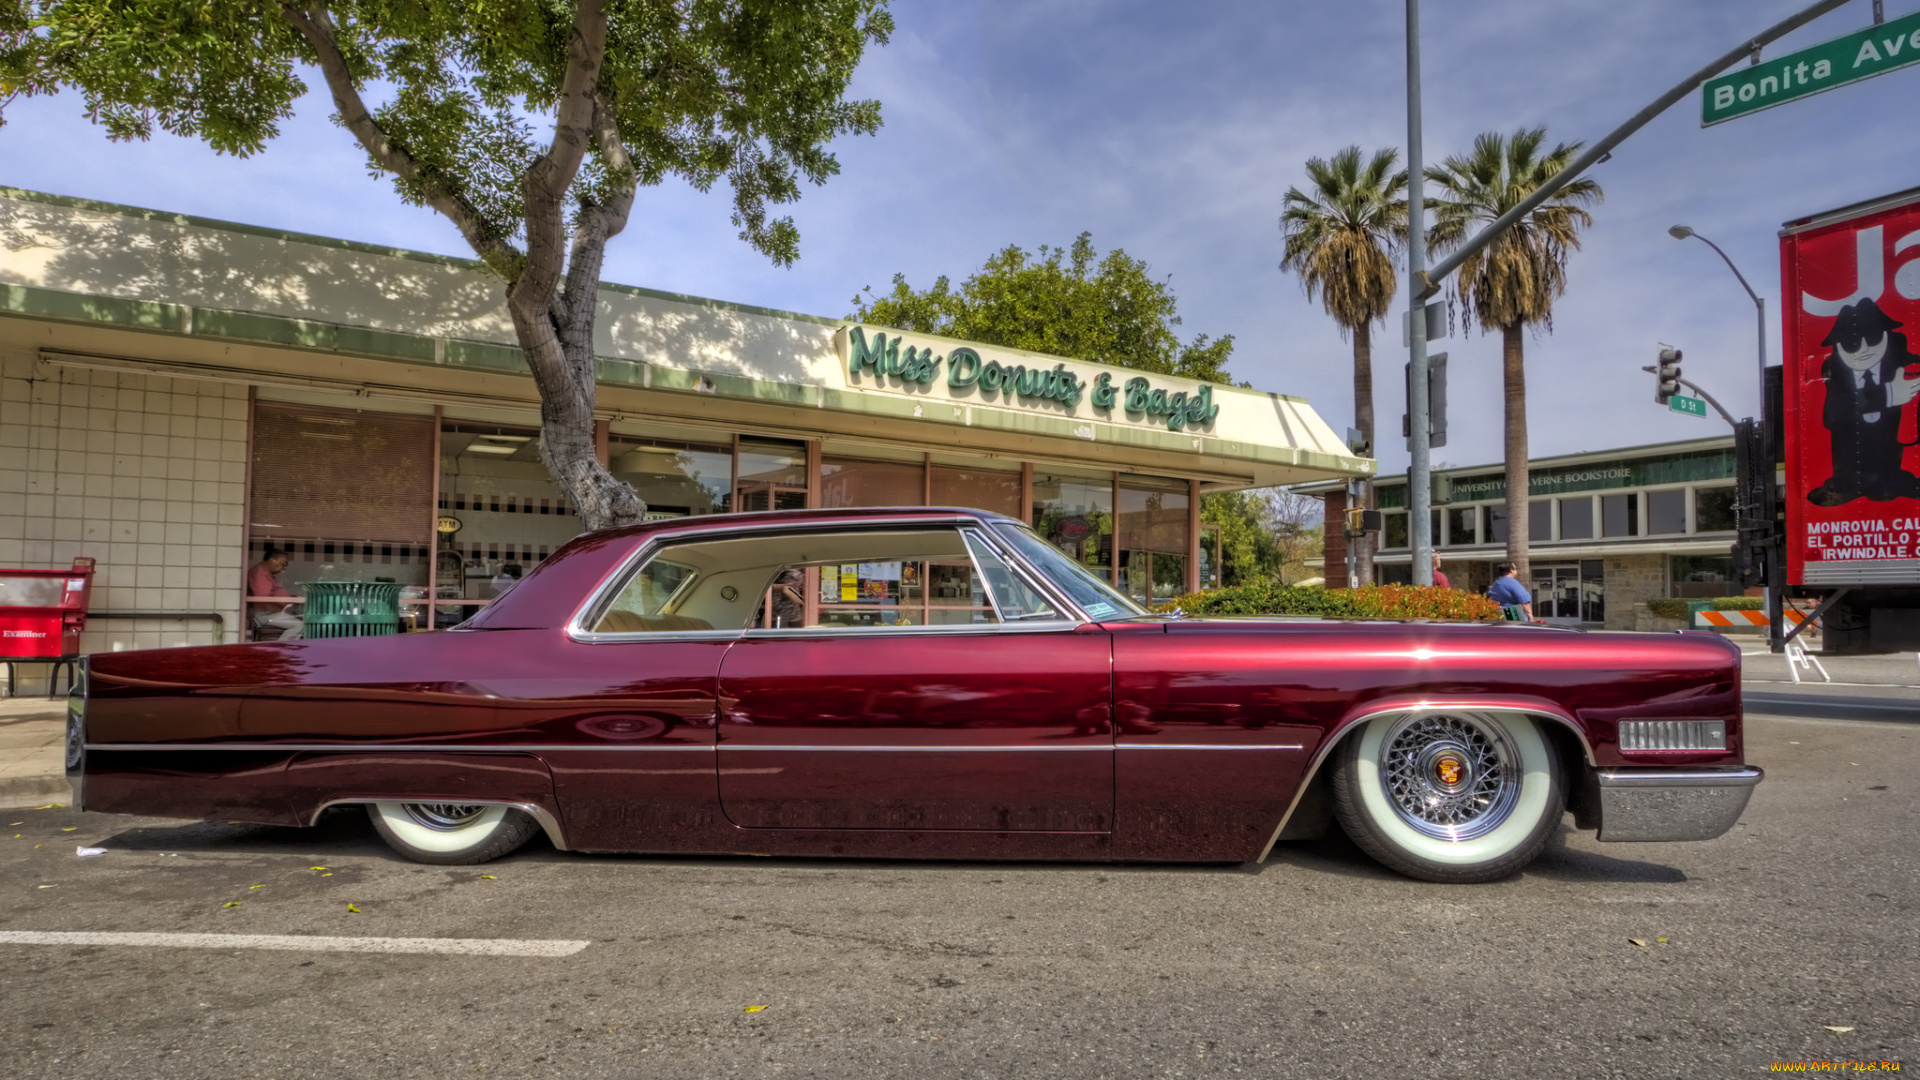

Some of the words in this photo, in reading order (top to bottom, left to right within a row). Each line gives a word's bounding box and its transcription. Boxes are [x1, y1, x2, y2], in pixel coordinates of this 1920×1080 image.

[1714, 59, 1831, 111] Bonita
[1852, 28, 1920, 68] Ave
[849, 326, 943, 383] Miss
[947, 347, 1086, 407] Donuts
[1091, 372, 1119, 411] &
[1124, 376, 1220, 431] Bagel
[1681, 399, 1686, 409] D
[1688, 401, 1696, 411] St
[1452, 481, 1502, 494] UNIVERSITY
[1531, 474, 1562, 486] VERNE
[1565, 468, 1631, 483] BOOKSTORE
[438, 521, 456, 529] ATM
[1807, 536, 1827, 548] EL
[1833, 533, 1910, 547] PORTILLO
[3, 630, 47, 638] Examiner
